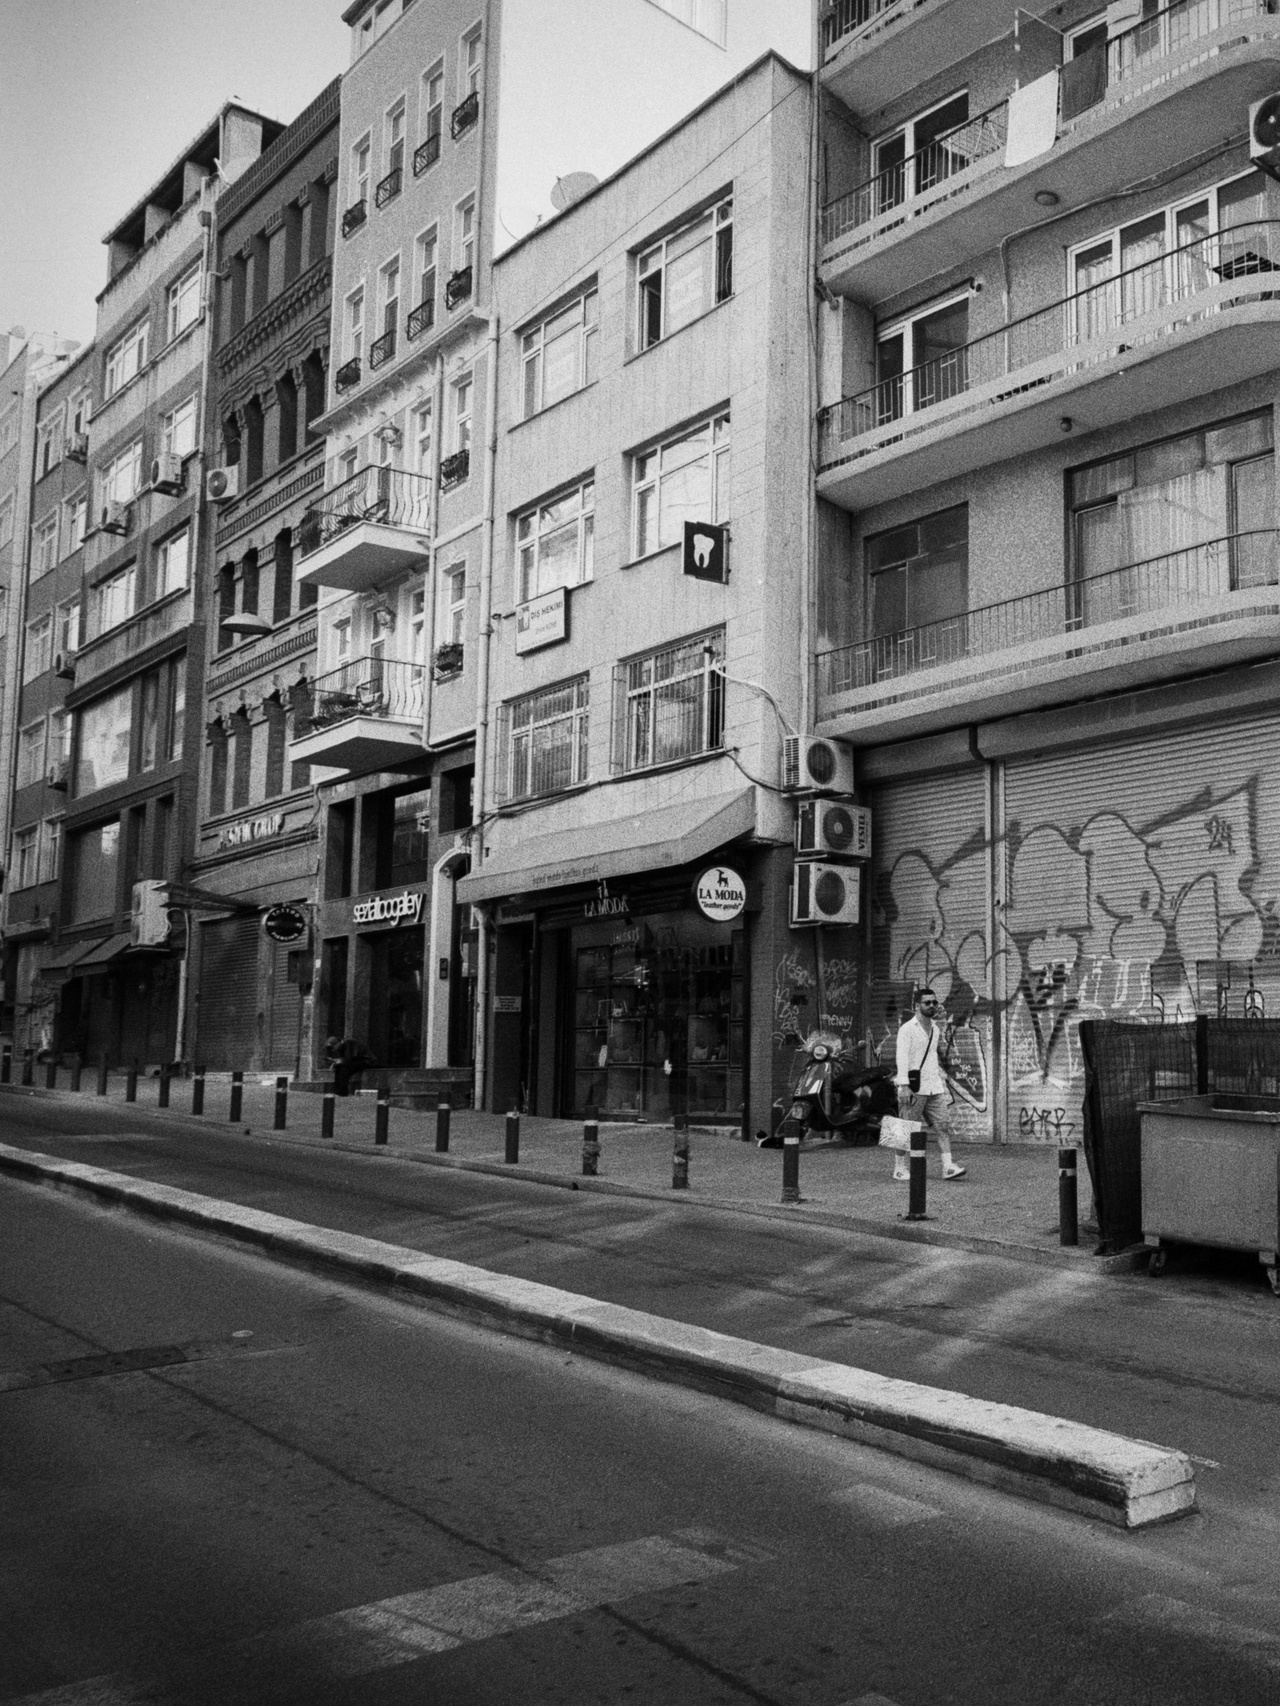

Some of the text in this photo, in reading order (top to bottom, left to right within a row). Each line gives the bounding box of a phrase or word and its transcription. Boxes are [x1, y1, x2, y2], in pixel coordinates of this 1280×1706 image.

[858, 813, 866, 850] VESTEL
[699, 888, 744, 901] LA MODA
[271, 907, 300, 918] TATTOO
[584, 896, 630, 918] LA MODA
